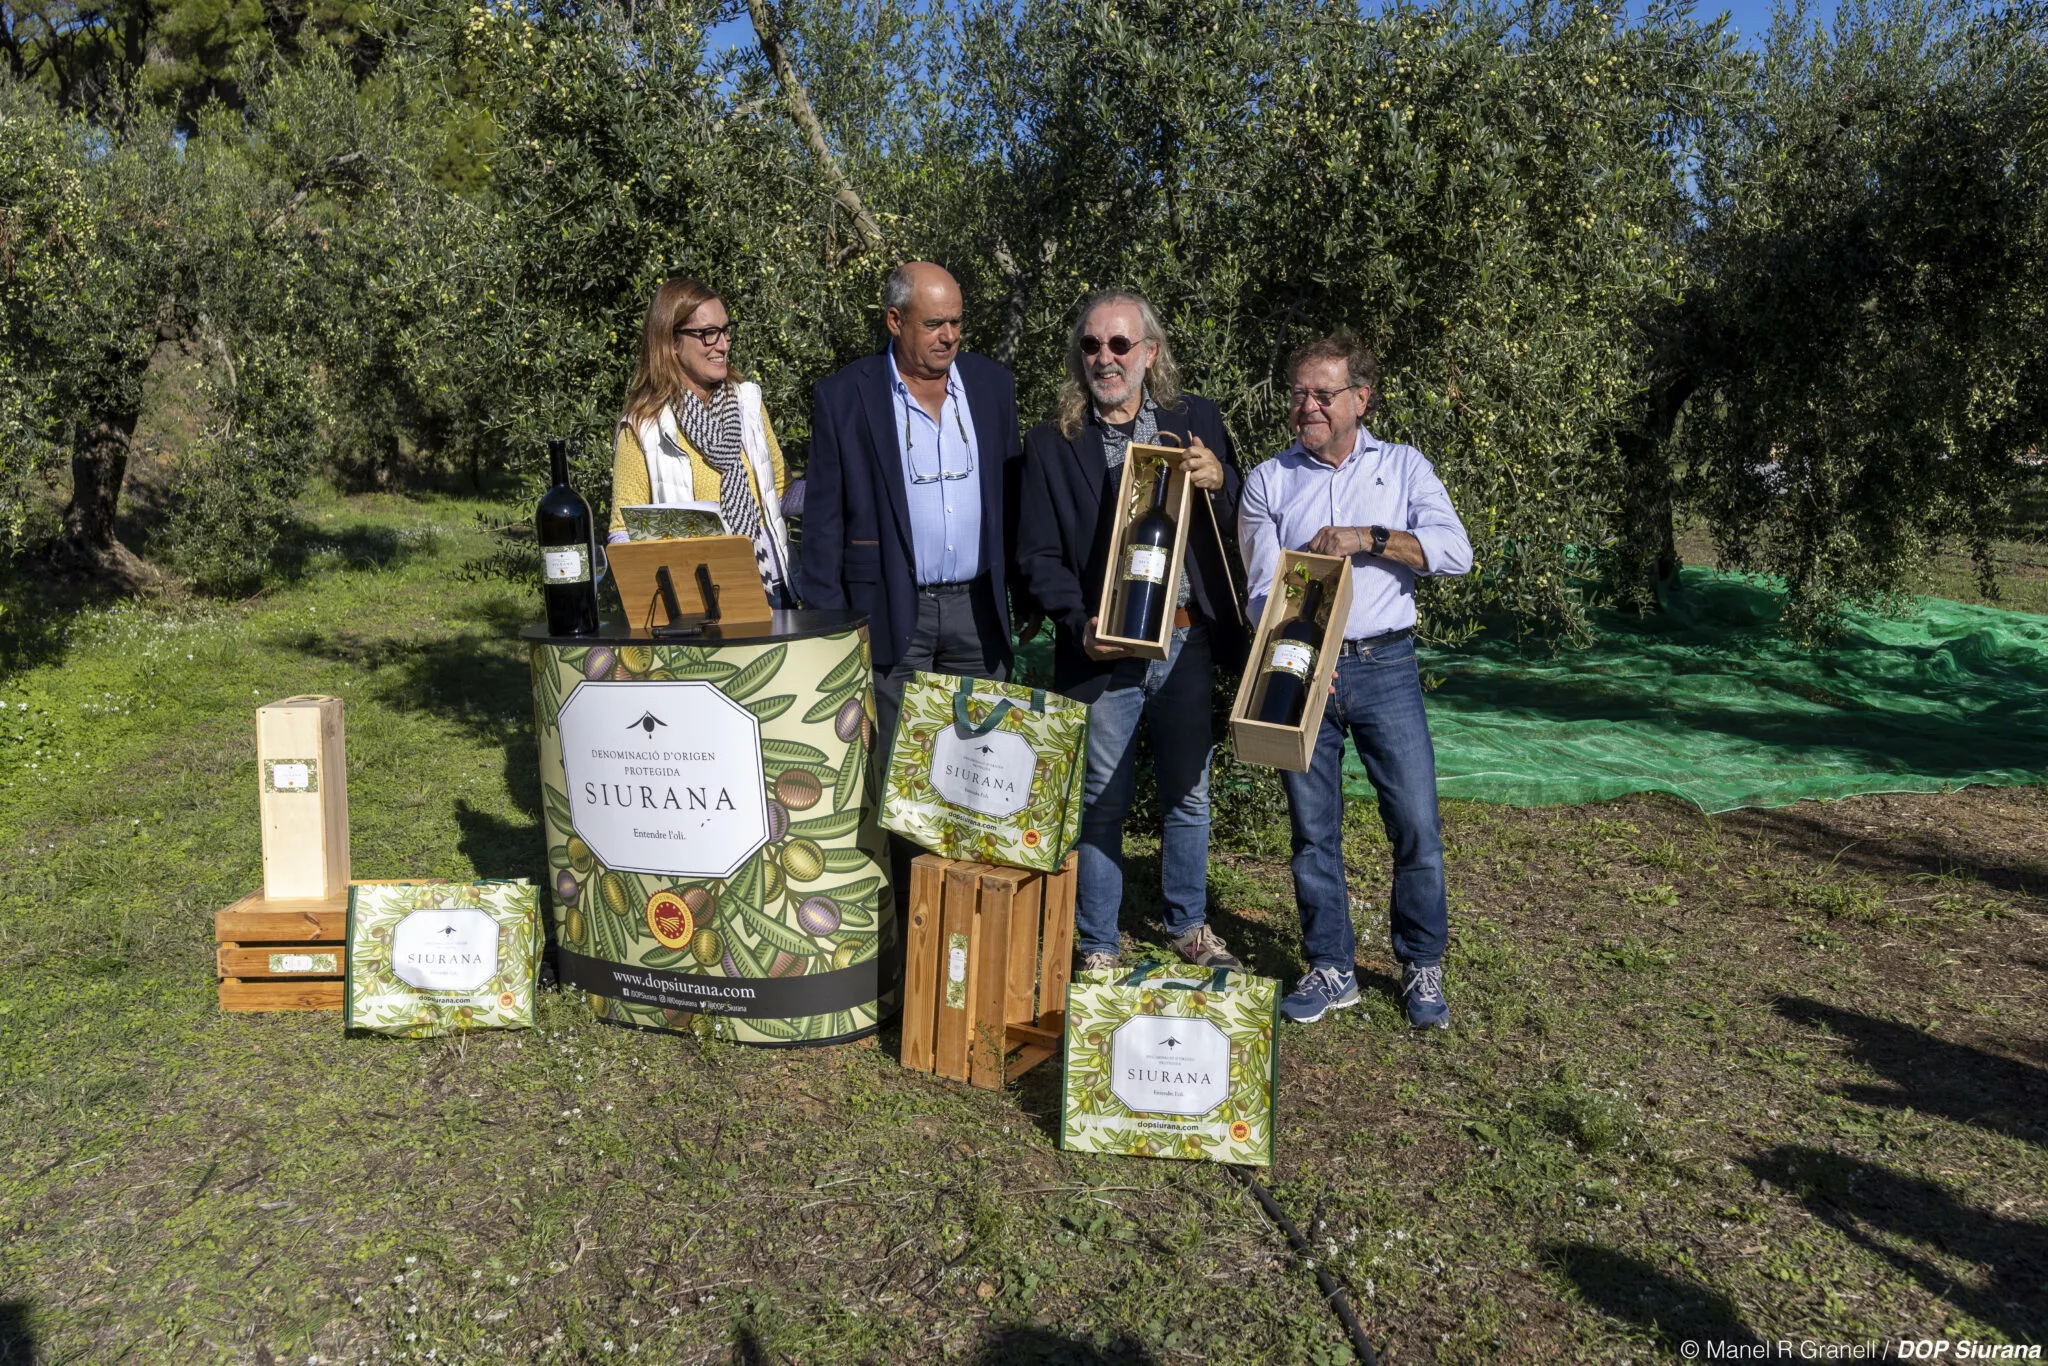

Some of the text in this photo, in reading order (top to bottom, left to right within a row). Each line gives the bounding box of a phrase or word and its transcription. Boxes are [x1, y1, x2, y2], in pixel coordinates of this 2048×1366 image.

[591, 749, 716, 761] DENOMINACIÓ D'ORIGEN
[624, 766, 681, 777] PROTEGIDA
[945, 764, 1015, 793] SIURANA
[585, 782, 737, 811] SIURANA
[948, 811, 998, 831] dopsiurana.com
[633, 828, 686, 840] Entendre l'oli.
[407, 953, 482, 965] SIURANA
[613, 971, 756, 999] www.dopsiurana.com
[418, 994, 471, 1004] dopsiurana.com
[1127, 1068, 1212, 1085] SIURANA
[1137, 1120, 1199, 1132] dopsiurana.com
